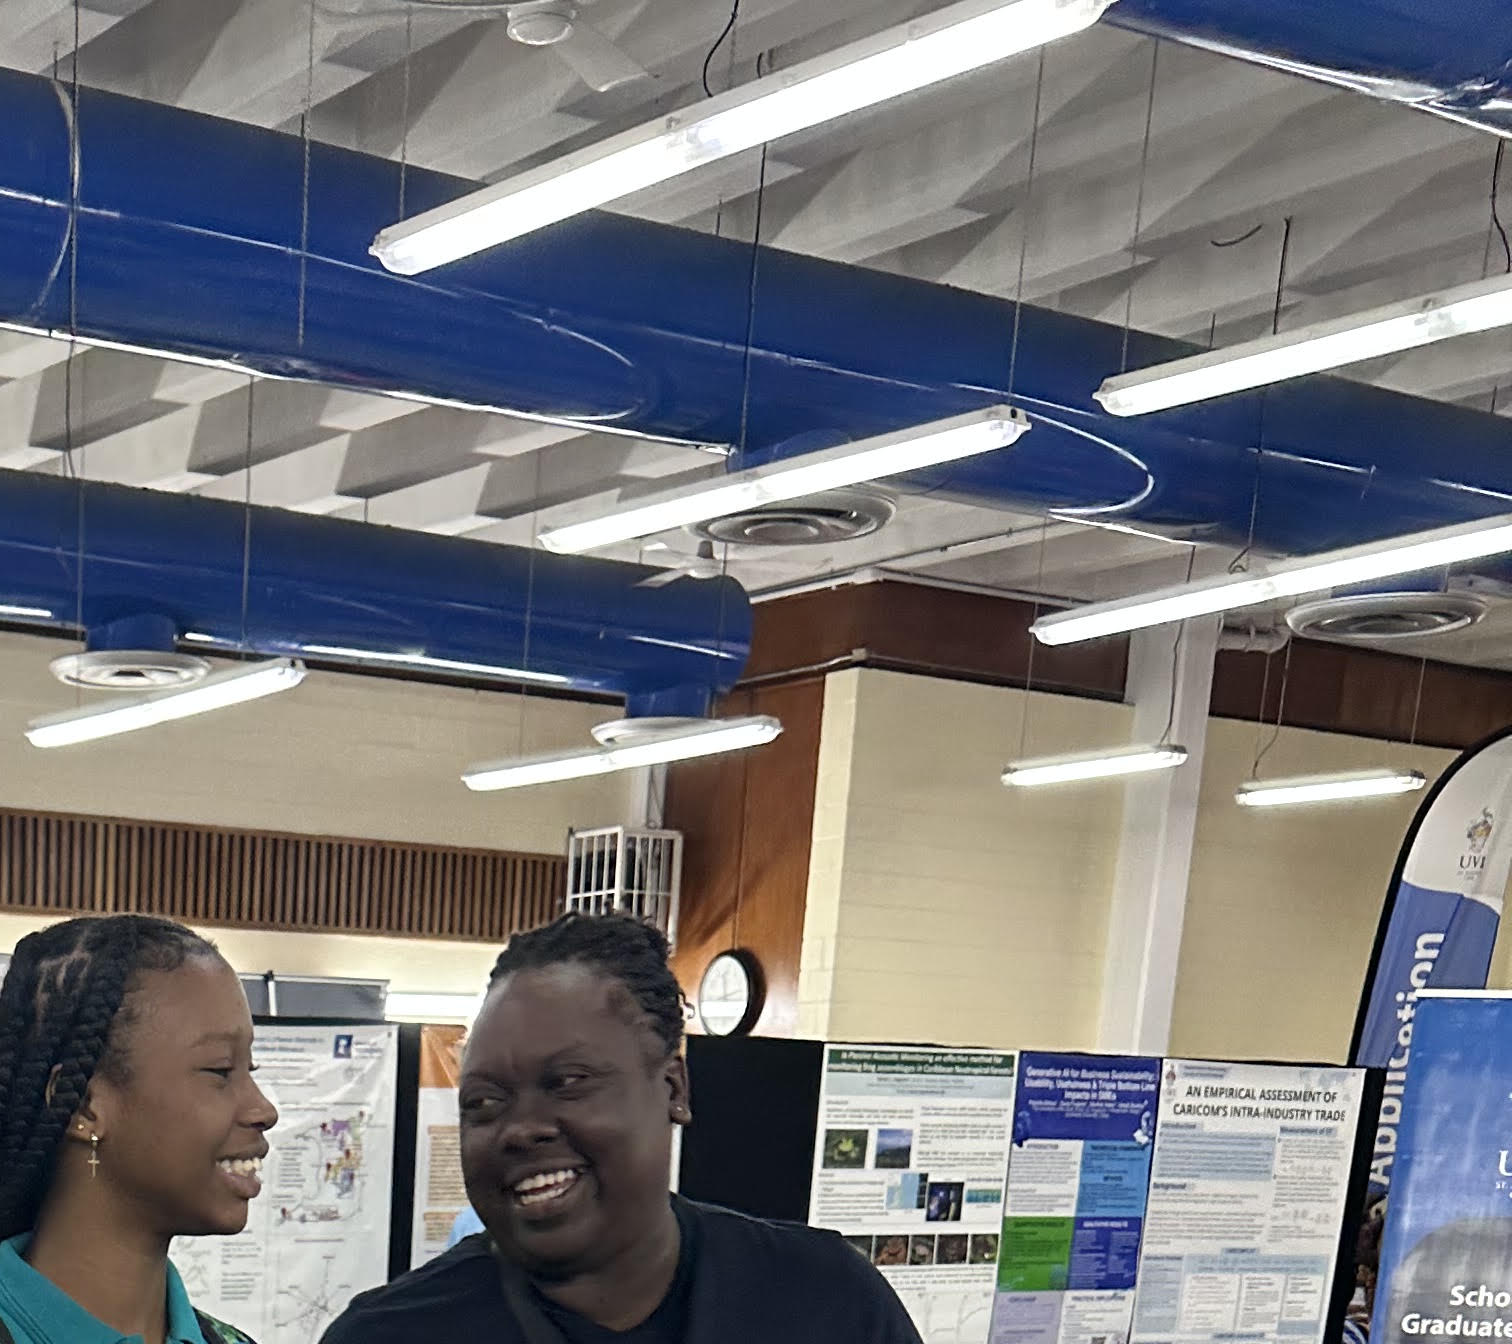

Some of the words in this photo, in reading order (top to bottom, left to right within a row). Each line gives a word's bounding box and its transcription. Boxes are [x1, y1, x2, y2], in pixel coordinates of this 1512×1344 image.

[1185, 1085, 1201, 1097] AN
[1204, 1086, 1256, 1100] EMPIRICAL
[1259, 1089, 1321, 1102] ASSESSMENT
[1323, 1091, 1338, 1103] OF
[1315, 1110, 1346, 1122] TRADE
[1450, 1285, 1512, 1307] Scho
